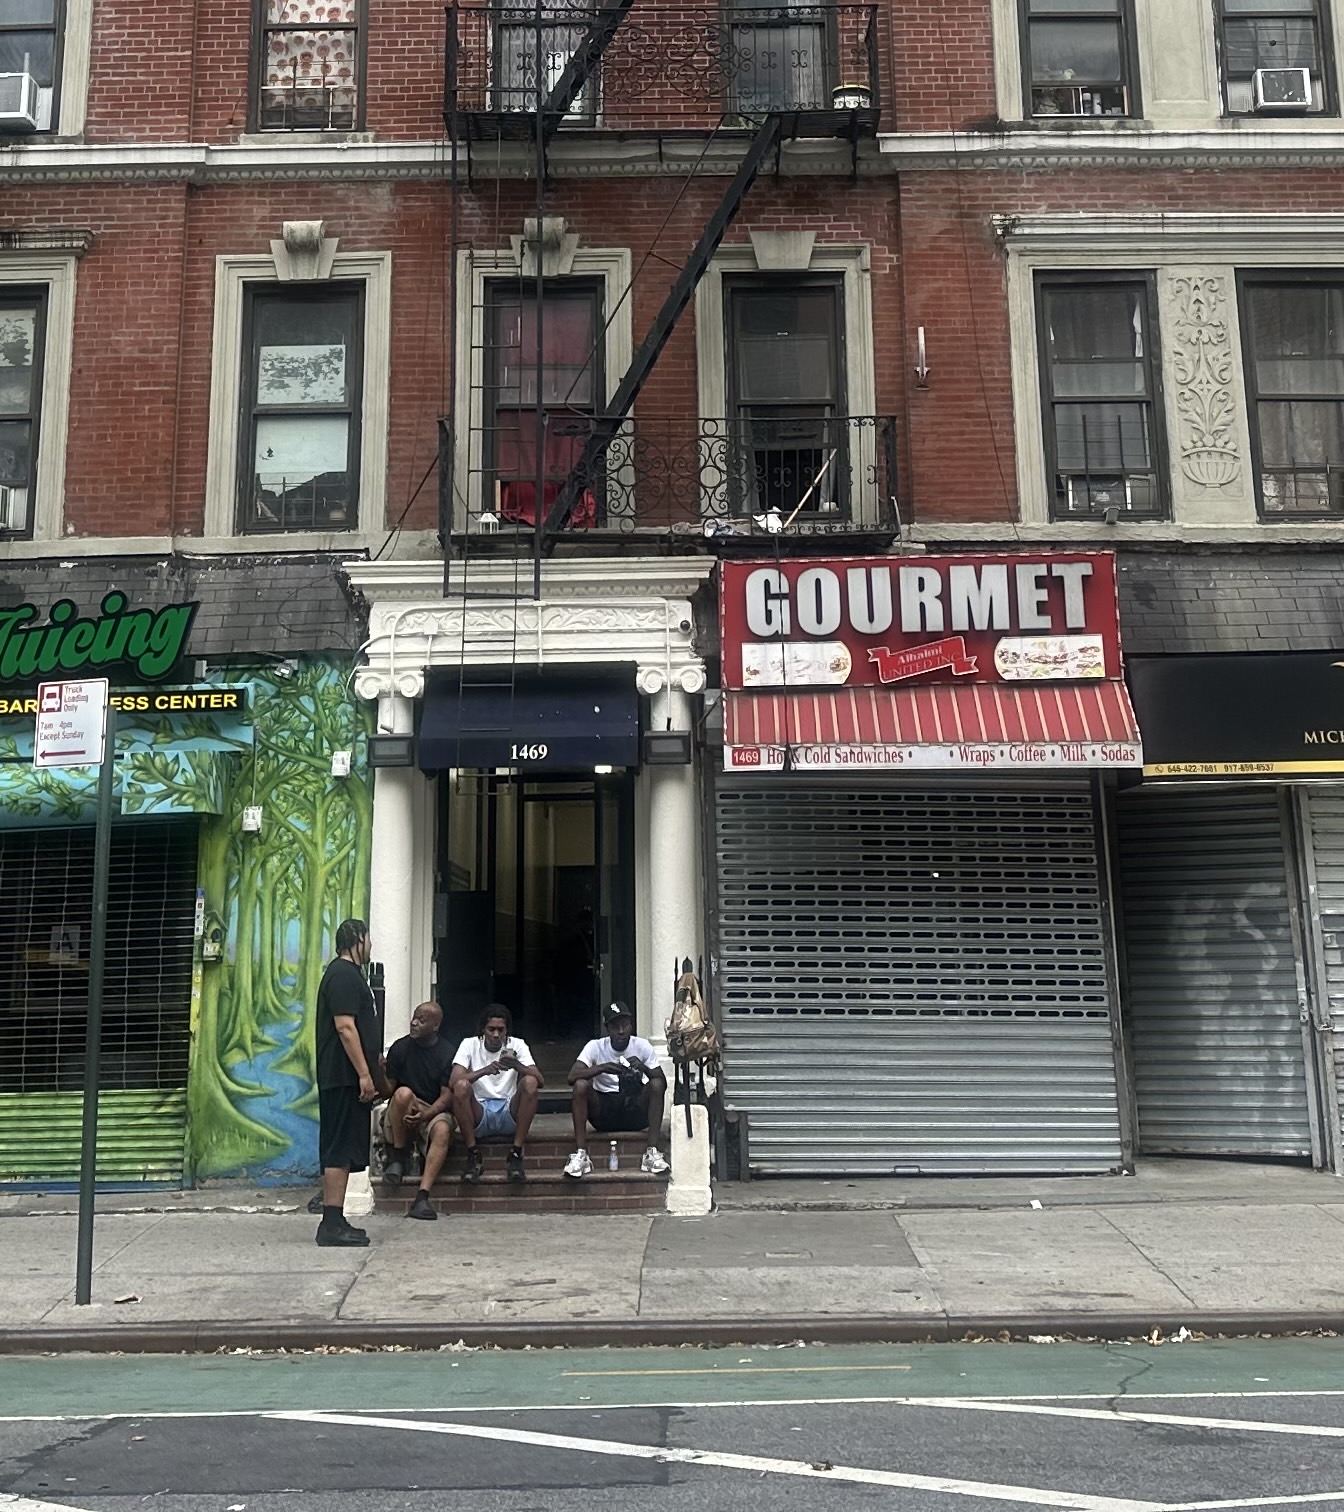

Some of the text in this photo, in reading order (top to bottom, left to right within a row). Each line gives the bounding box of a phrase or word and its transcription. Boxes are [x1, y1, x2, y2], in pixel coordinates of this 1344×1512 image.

[745, 562, 1094, 636] GOURMET
[155, 692, 237, 710] CENTER
[39, 732, 60, 741] Except
[510, 744, 548, 760] 1469
[733, 751, 759, 764] 1469
[804, 747, 831, 763] Cold
[834, 746, 904, 763] Sandwiches
[958, 746, 996, 766] Wraps
[1009, 746, 1046, 762] Coffee
[1060, 744, 1087, 762] Milk
[1100, 744, 1136, 761] Sodas
